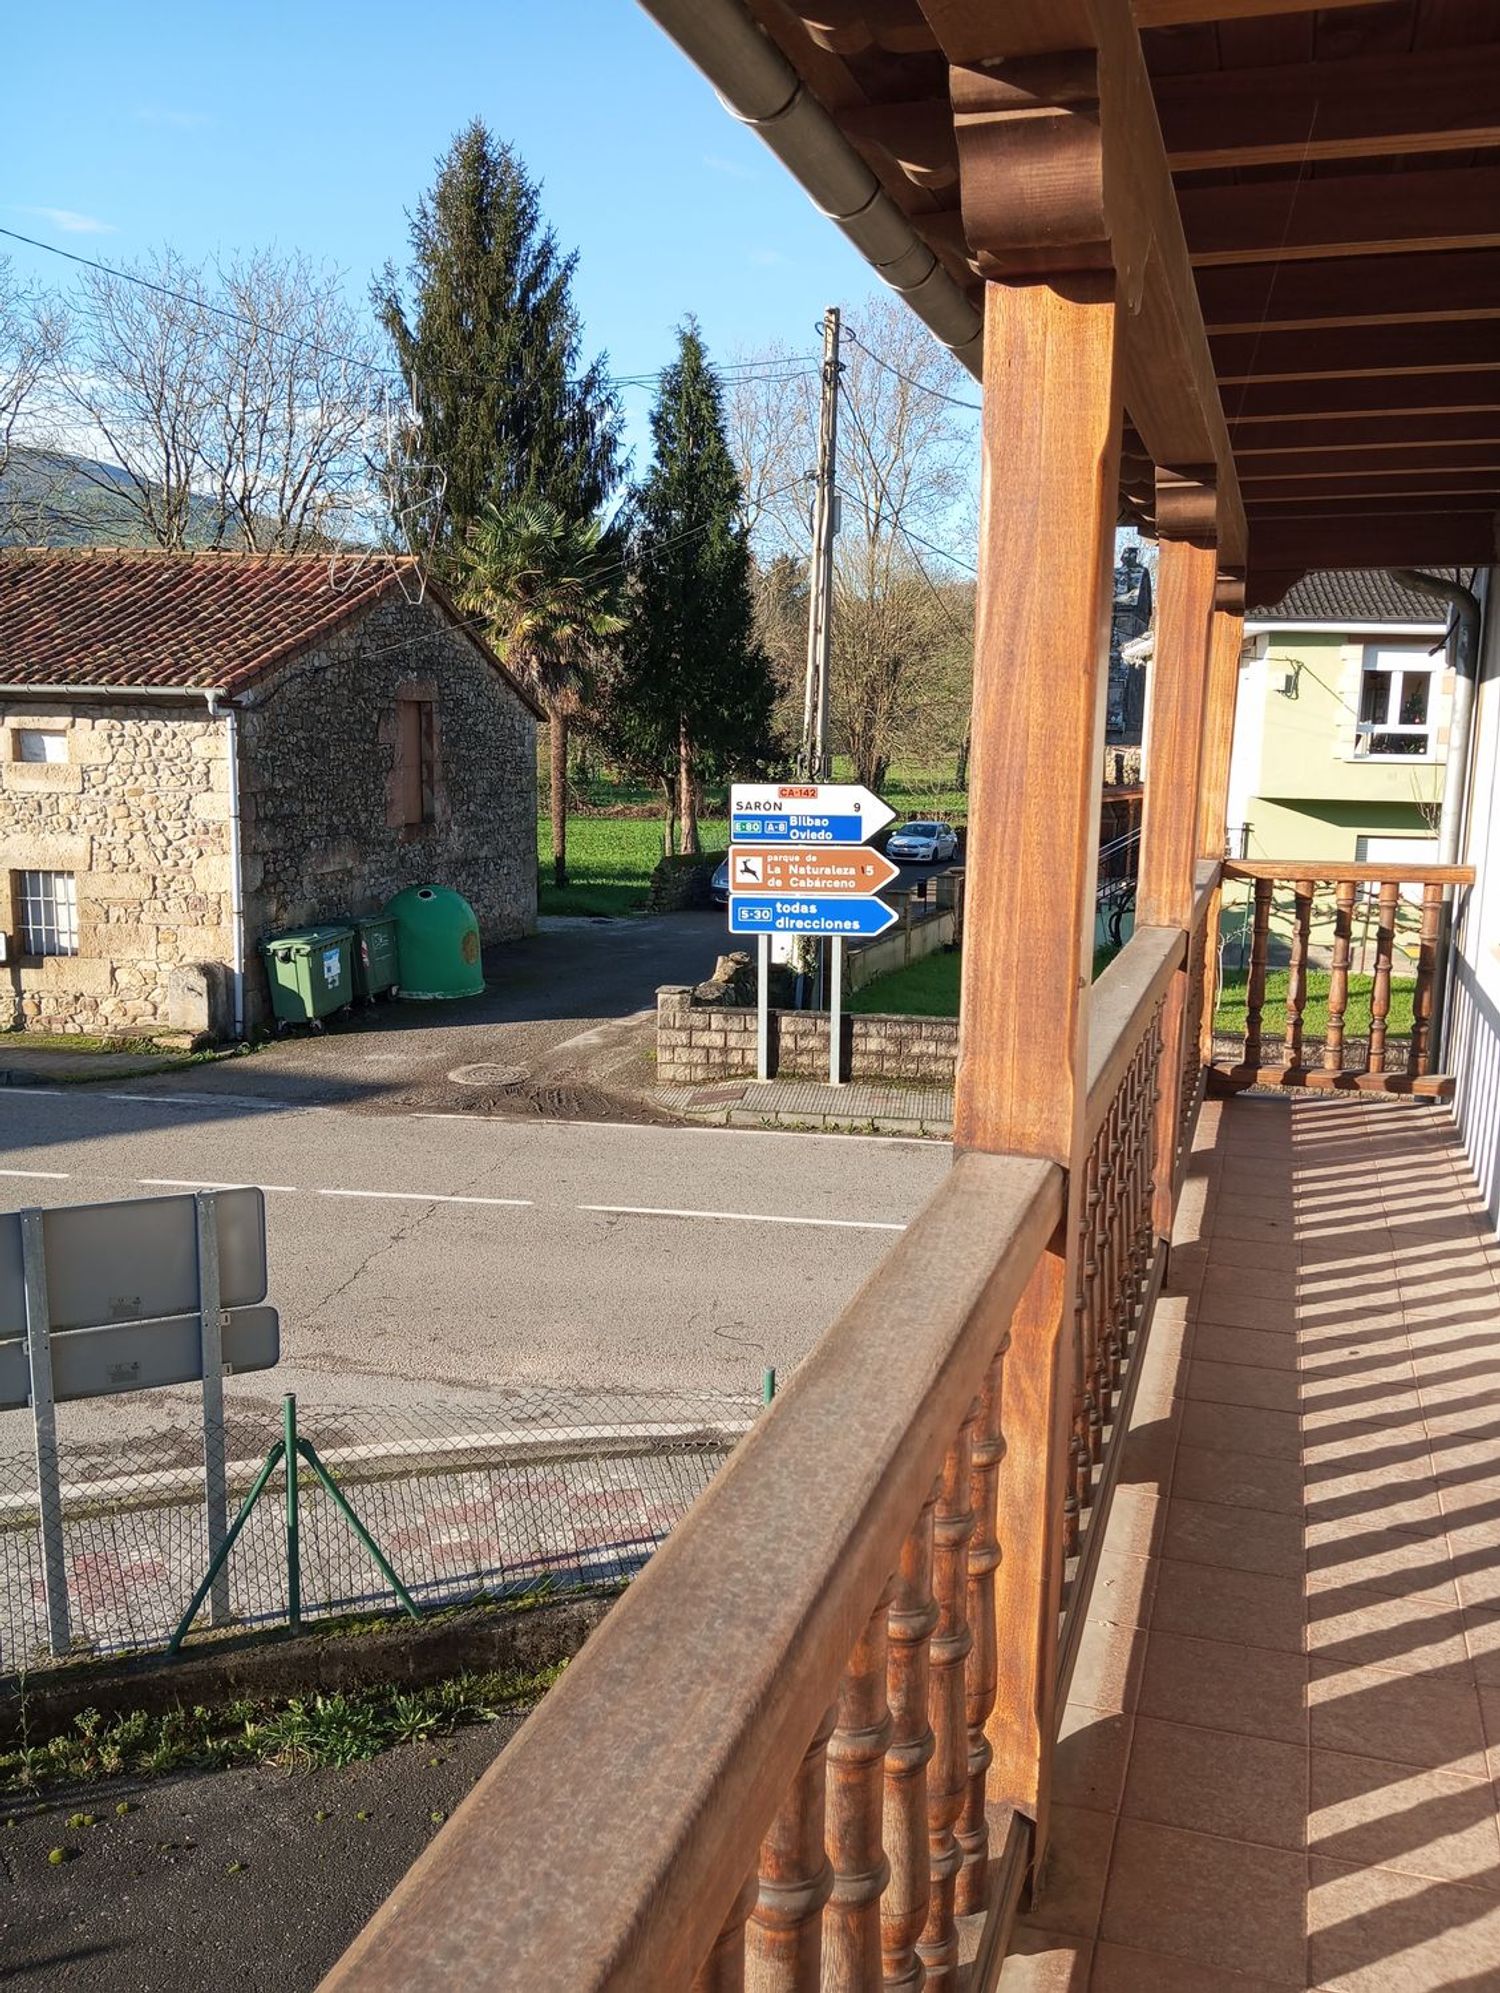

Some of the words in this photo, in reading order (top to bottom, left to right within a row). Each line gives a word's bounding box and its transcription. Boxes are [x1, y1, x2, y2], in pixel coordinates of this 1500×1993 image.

[779, 788, 816, 798] CA-142
[736, 800, 783, 812] SARÓN
[853, 802, 861, 813] 9
[789, 816, 829, 827] Bilbao
[789, 829, 833, 840] Oviedo
[767, 855, 800, 863] parque
[805, 854, 817, 862] de
[767, 864, 781, 875] La
[788, 865, 856, 876] Naturaleza
[767, 878, 782, 887] de
[789, 878, 856, 888] Cabárceno
[775, 901, 818, 914] todas
[775, 917, 861, 930] direcciones
